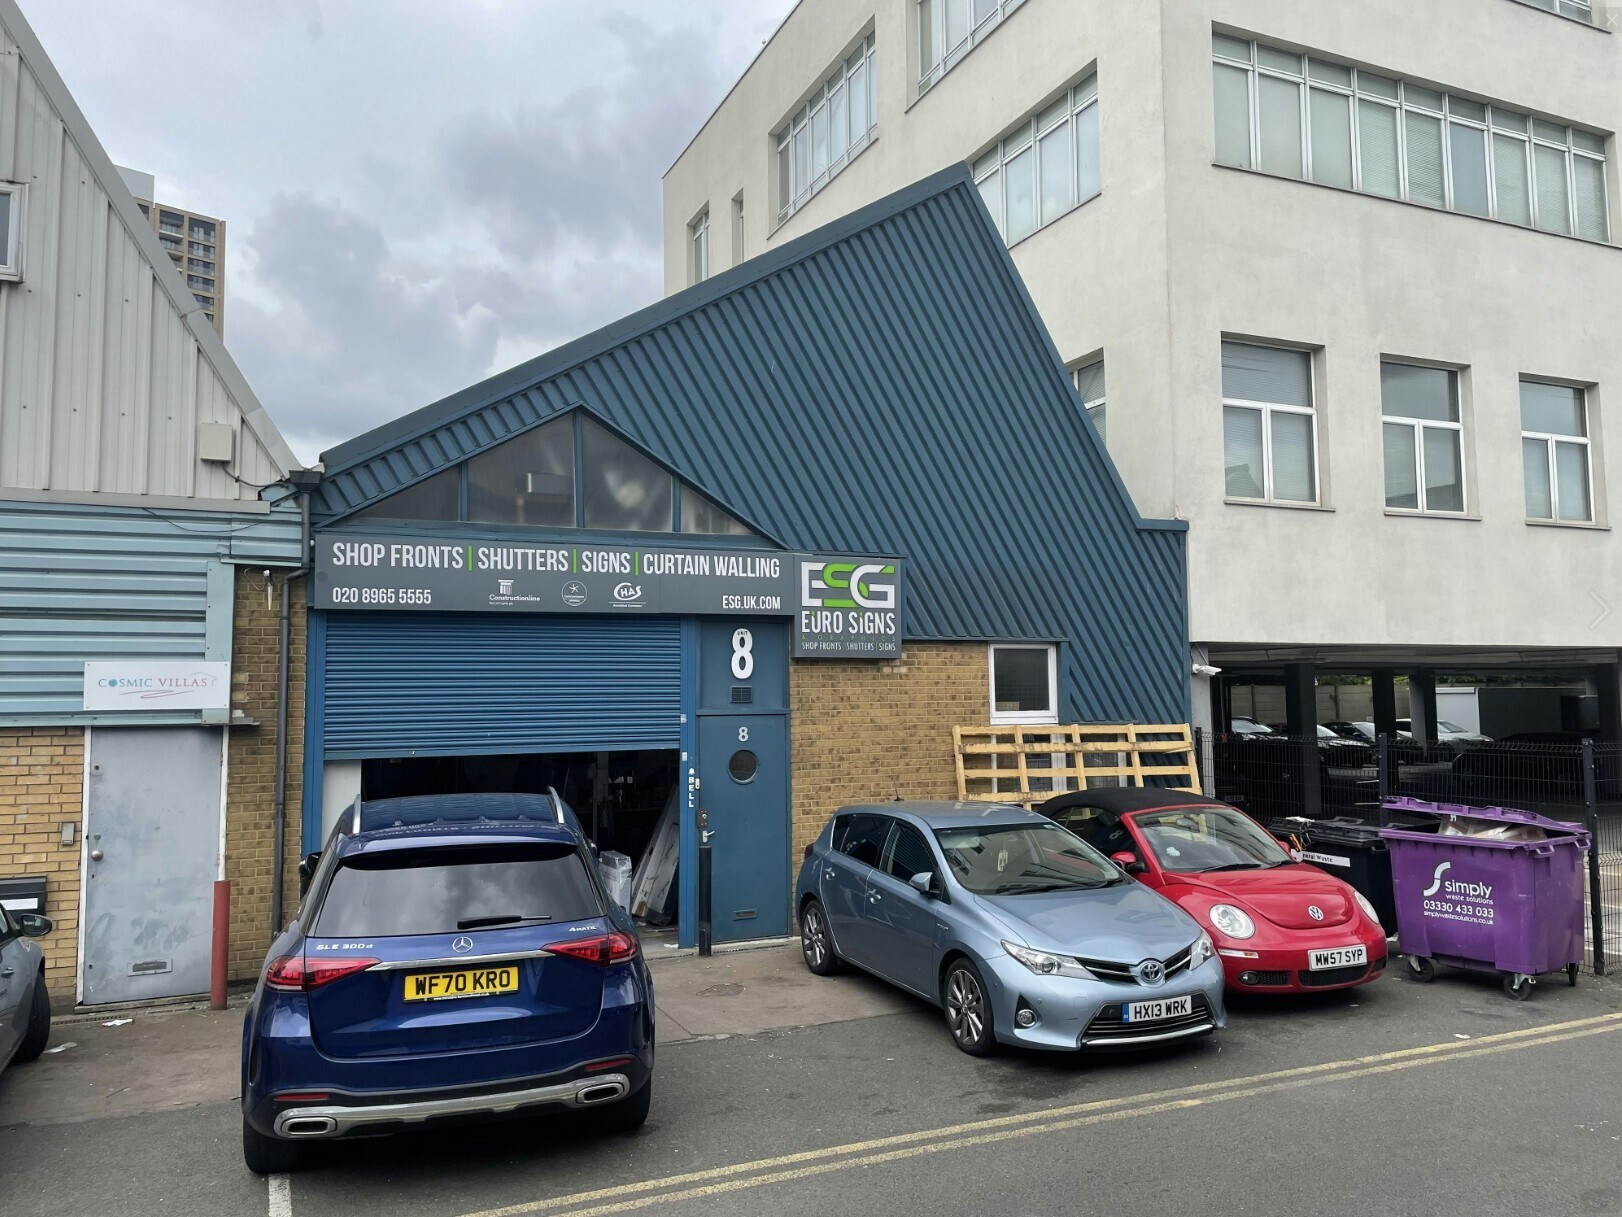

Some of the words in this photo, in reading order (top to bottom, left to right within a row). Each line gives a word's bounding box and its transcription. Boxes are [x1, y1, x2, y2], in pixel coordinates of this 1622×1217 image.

[332, 542, 386, 567] SHOP
[390, 544, 464, 569] FRONTS
[477, 547, 569, 572] SHUTTERS
[581, 550, 631, 574] SIGNS
[643, 553, 710, 576] CURTAIN
[714, 555, 780, 578] WALLING
[613, 582, 642, 601] CHAS
[801, 561, 895, 609] ESG
[332, 587, 359, 603] 020
[361, 587, 396, 604] 8965
[398, 589, 432, 605] 5555
[488, 593, 541, 602] Constructionline
[722, 595, 781, 610] ESG.UK.COM
[801, 610, 843, 634] EURO
[801, 641, 817, 650] SHOP
[819, 642, 842, 651] FRONTS
[846, 642, 875, 652] SHUTTERS
[878, 643, 896, 652] SIGNS
[817, 634, 896, 643] GRAPHICS
[731, 628, 754, 680] 8
[98, 678, 153, 688] COSMIC
[158, 678, 208, 688] VILLAS
[738, 726, 749, 742] 8
[1444, 879, 1492, 899] simply
[1423, 900, 1453, 912] 03330
[1455, 904, 1473, 915] 433
[1475, 907, 1494, 918] 033
[1466, 896, 1494, 905] solutions
[1315, 951, 1342, 966] MW57
[1345, 948, 1363, 963] SYP
[415, 973, 467, 996] WF70
[472, 969, 511, 990] KRO
[1134, 1003, 1162, 1020] HX13
[1165, 999, 1187, 1016] WRK
